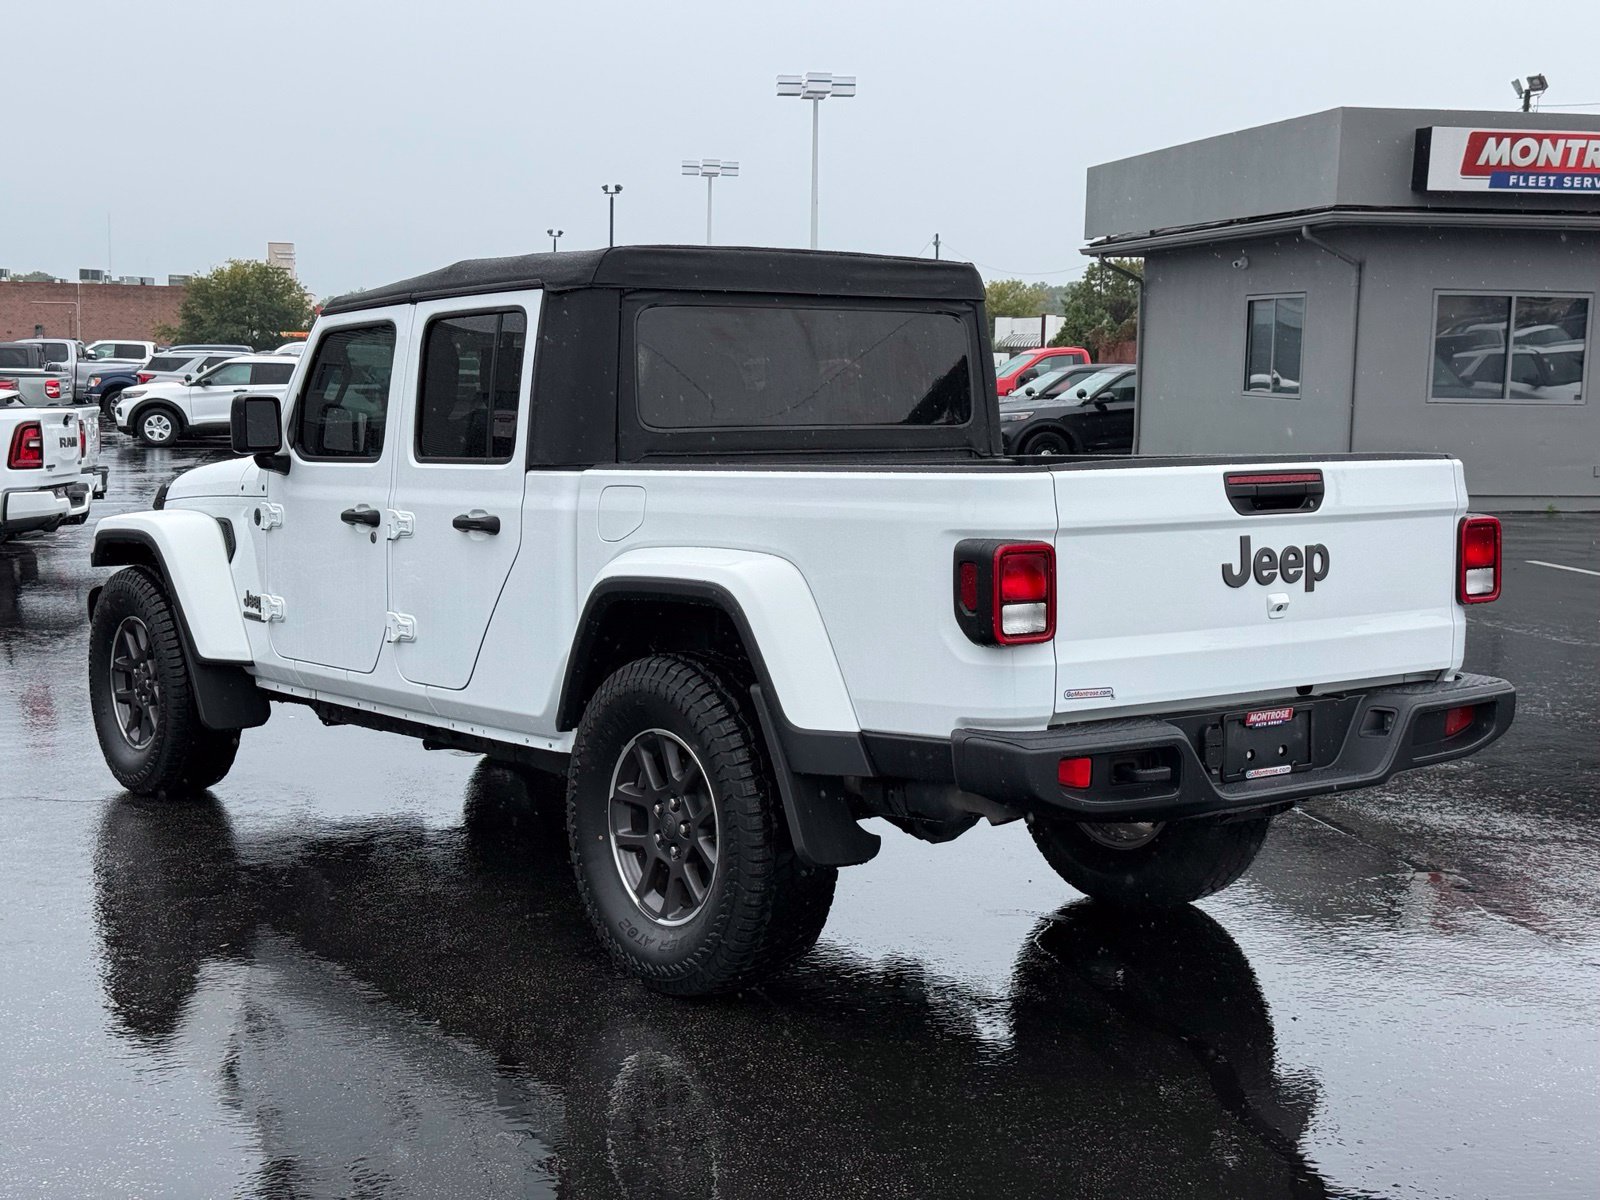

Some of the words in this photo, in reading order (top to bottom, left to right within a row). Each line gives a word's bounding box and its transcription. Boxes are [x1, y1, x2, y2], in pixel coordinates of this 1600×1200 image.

[1475, 136, 1600, 169] MONTR
[1509, 174, 1556, 187] FLEET
[59, 437, 77, 448] RAM
[1221, 535, 1330, 593] Jeep
[1249, 709, 1290, 722] MONTROSE
